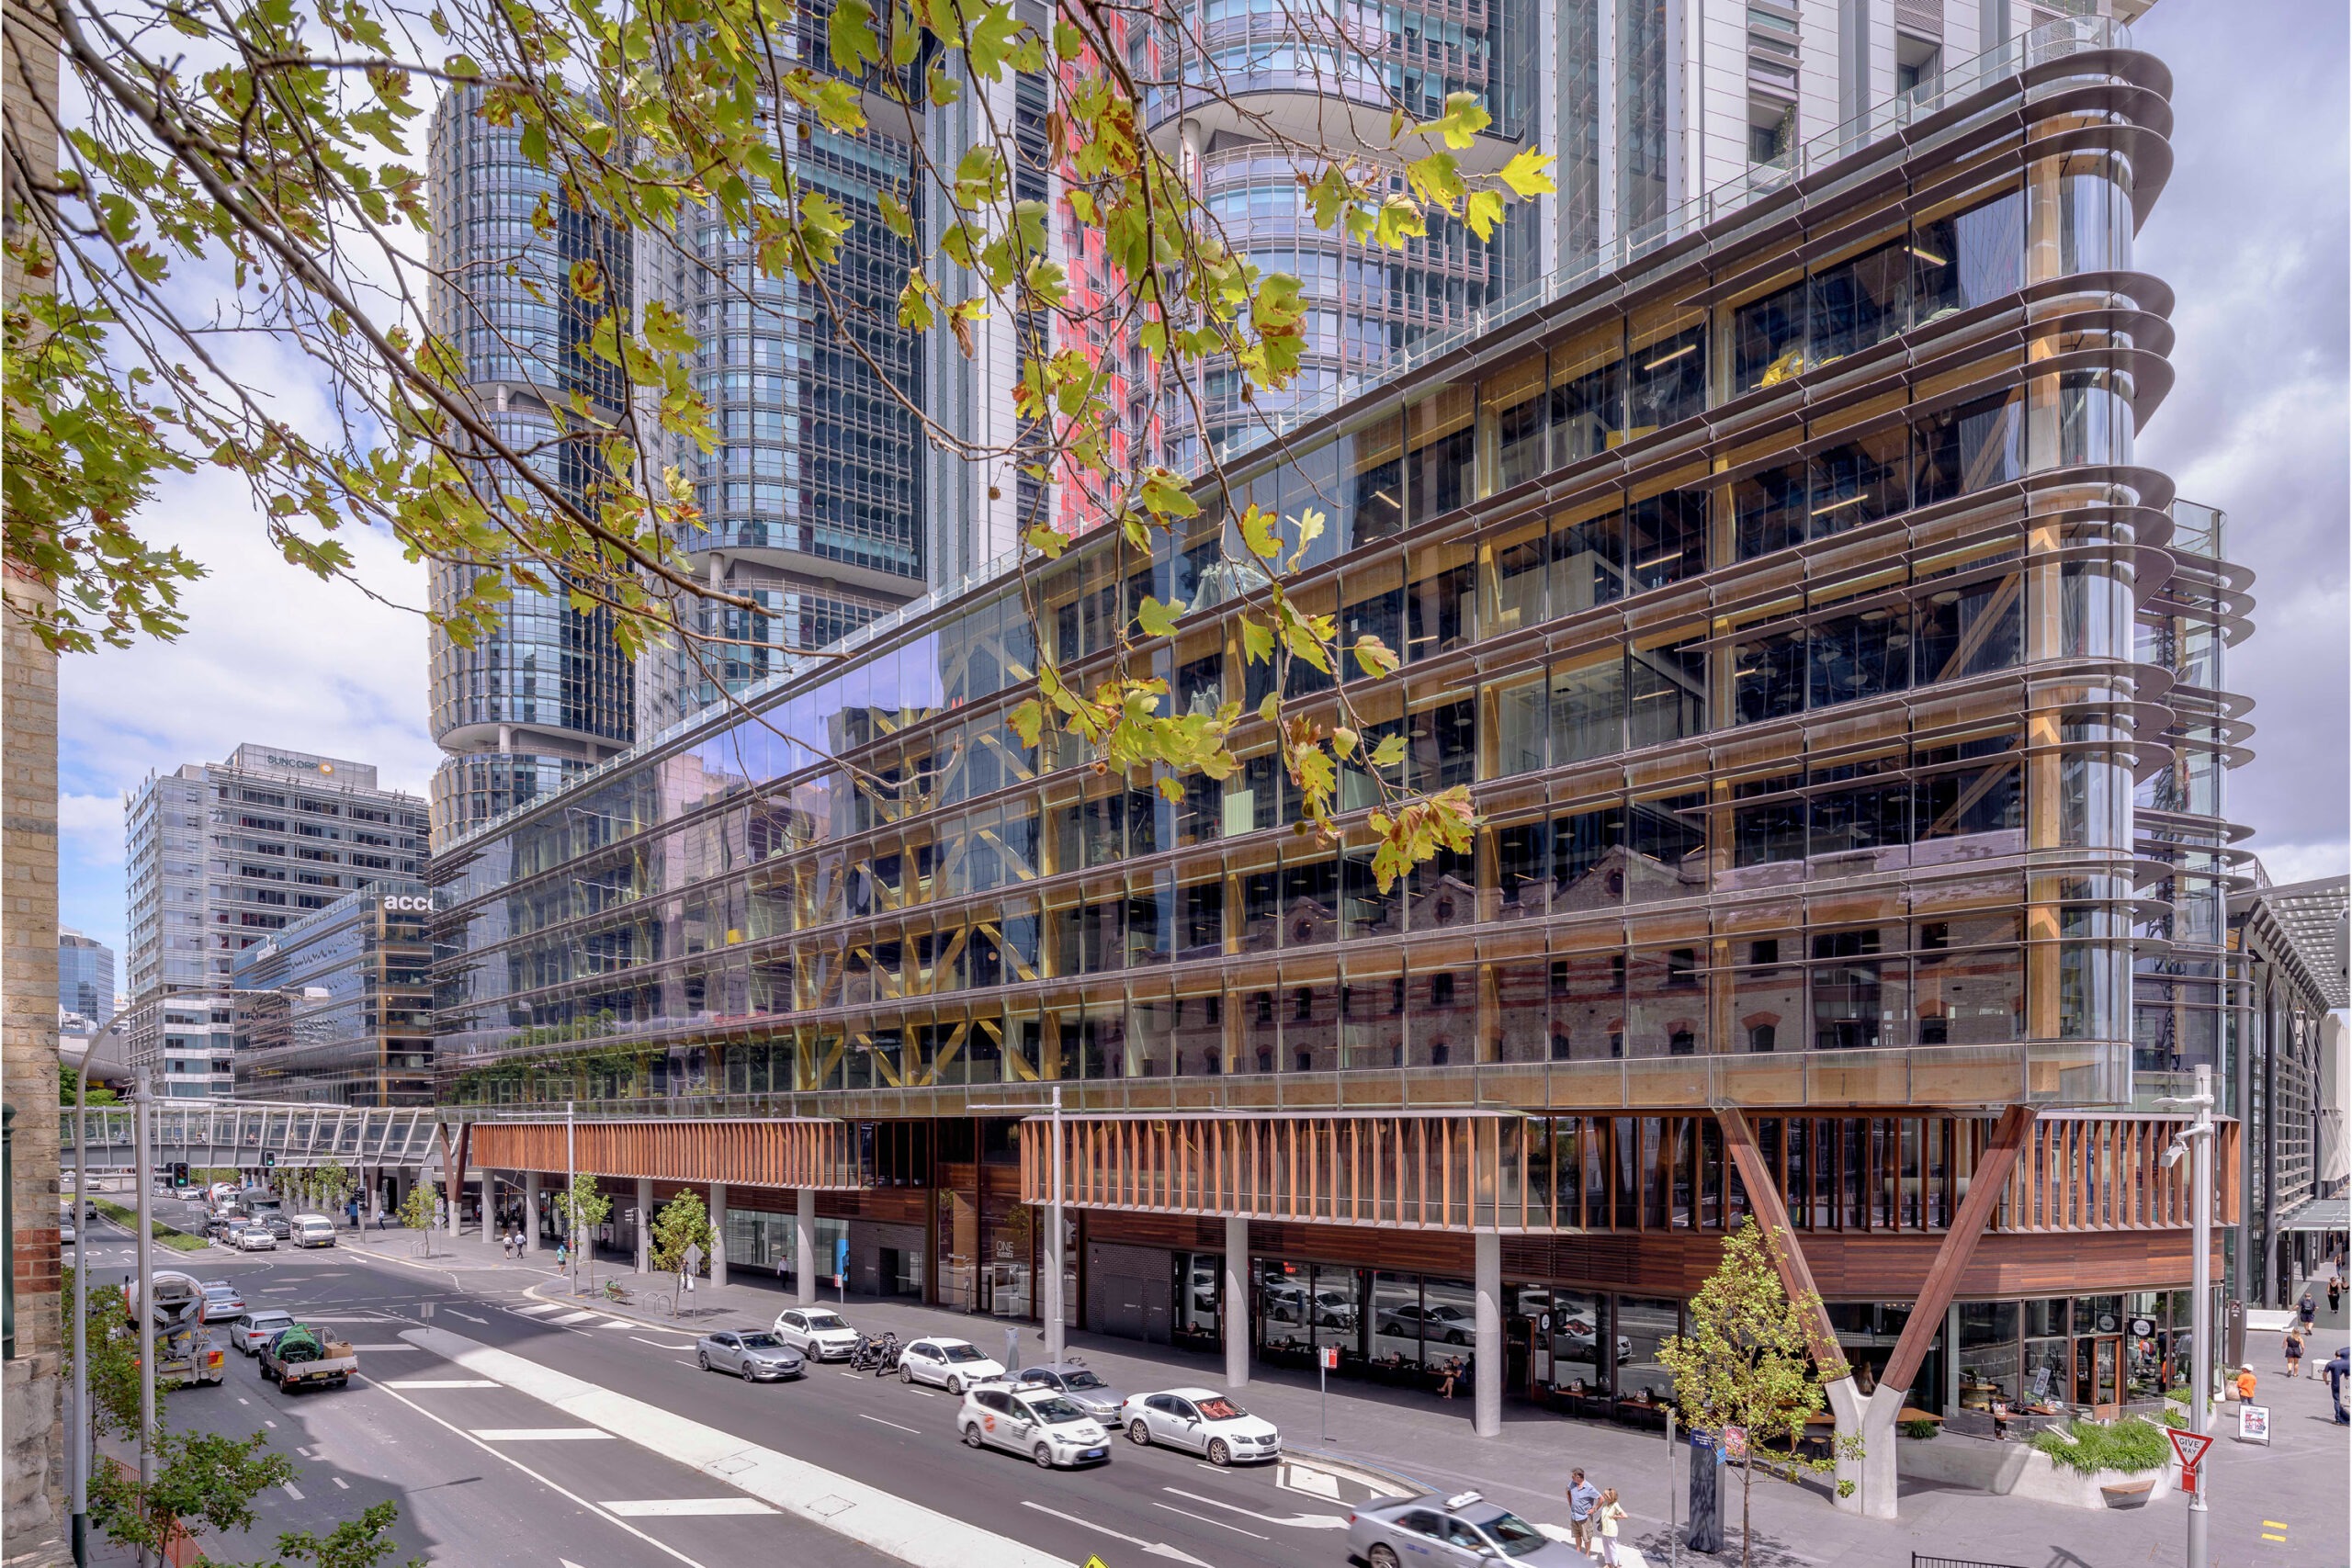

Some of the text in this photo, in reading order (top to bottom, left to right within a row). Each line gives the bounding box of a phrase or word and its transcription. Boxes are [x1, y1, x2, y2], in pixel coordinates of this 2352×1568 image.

[267, 755, 318, 770] SUNCORP
[996, 1240, 1014, 1253] ONE
[2179, 1438, 2200, 1449] GIVE
